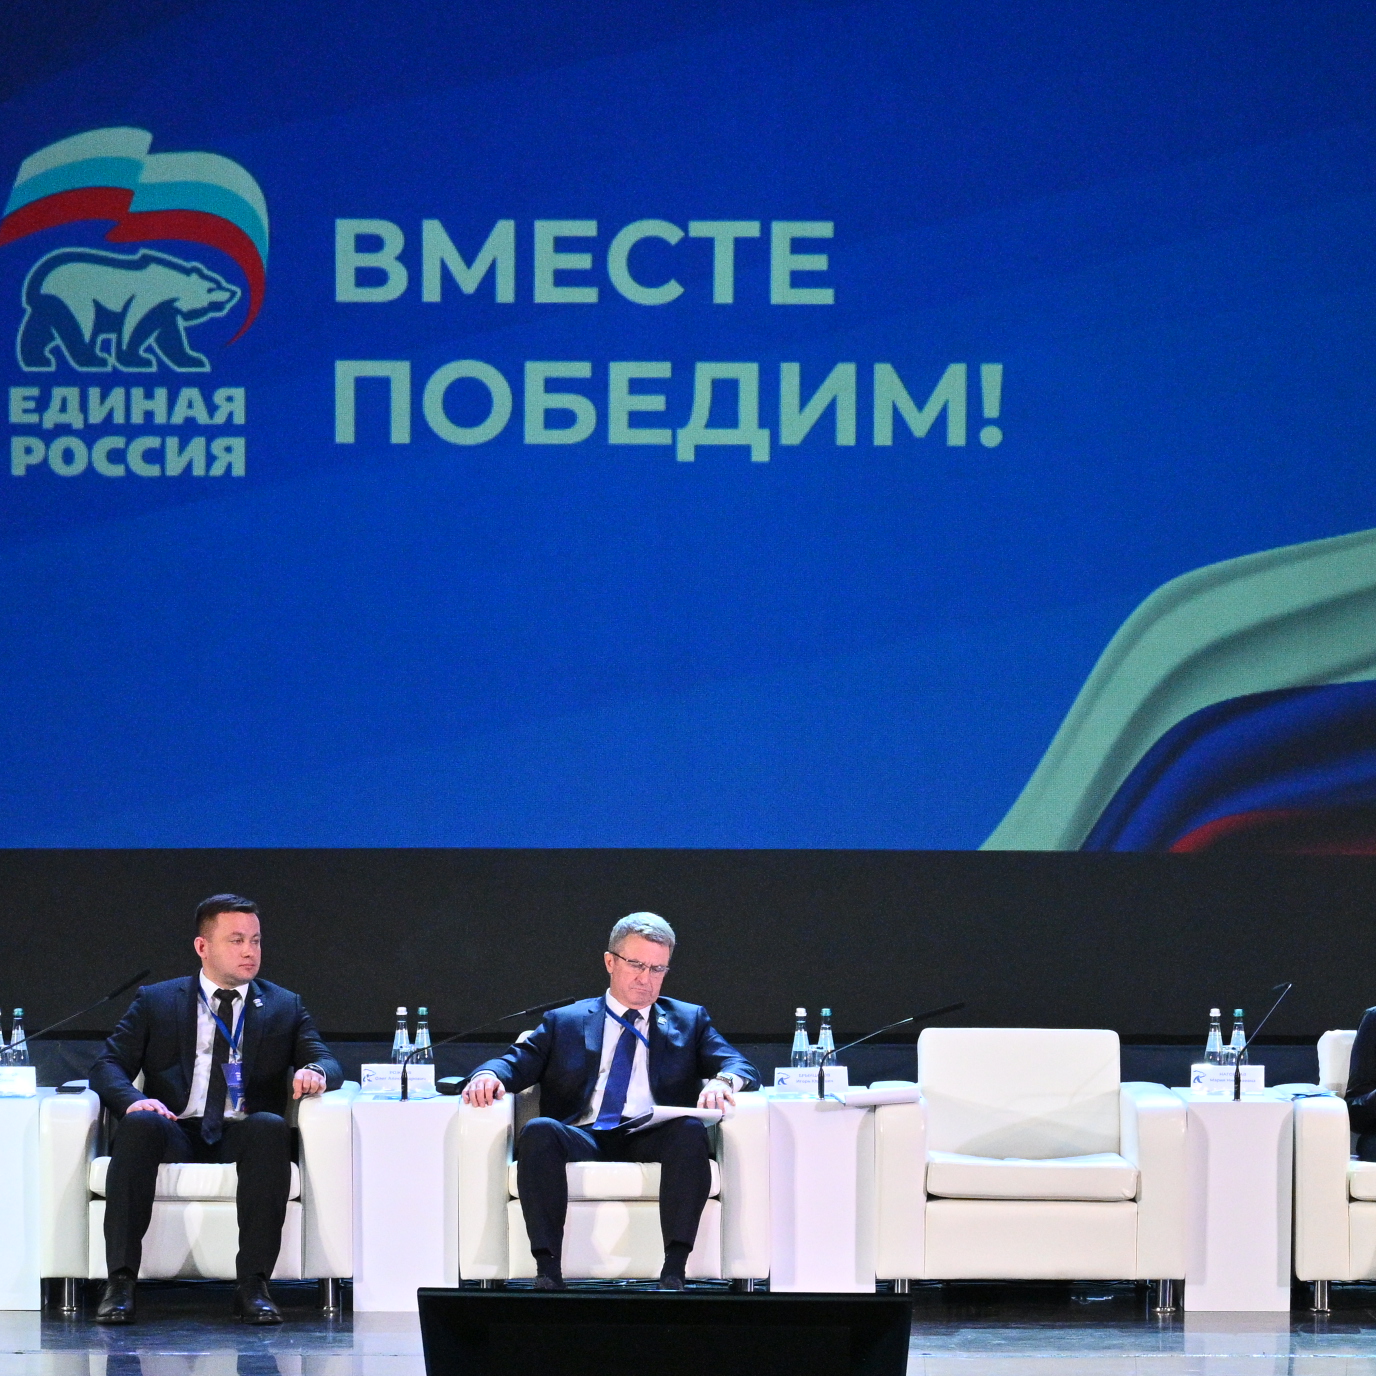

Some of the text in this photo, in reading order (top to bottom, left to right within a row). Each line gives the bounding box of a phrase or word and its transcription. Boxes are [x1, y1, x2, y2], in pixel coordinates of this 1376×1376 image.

[336, 220, 833, 305] ВМЕСТЕ
[11, 388, 245, 428] ЕДИНАЯ
[336, 360, 1002, 462] ПОБЕДИМ!
[13, 437, 245, 476] РОССИЯ
